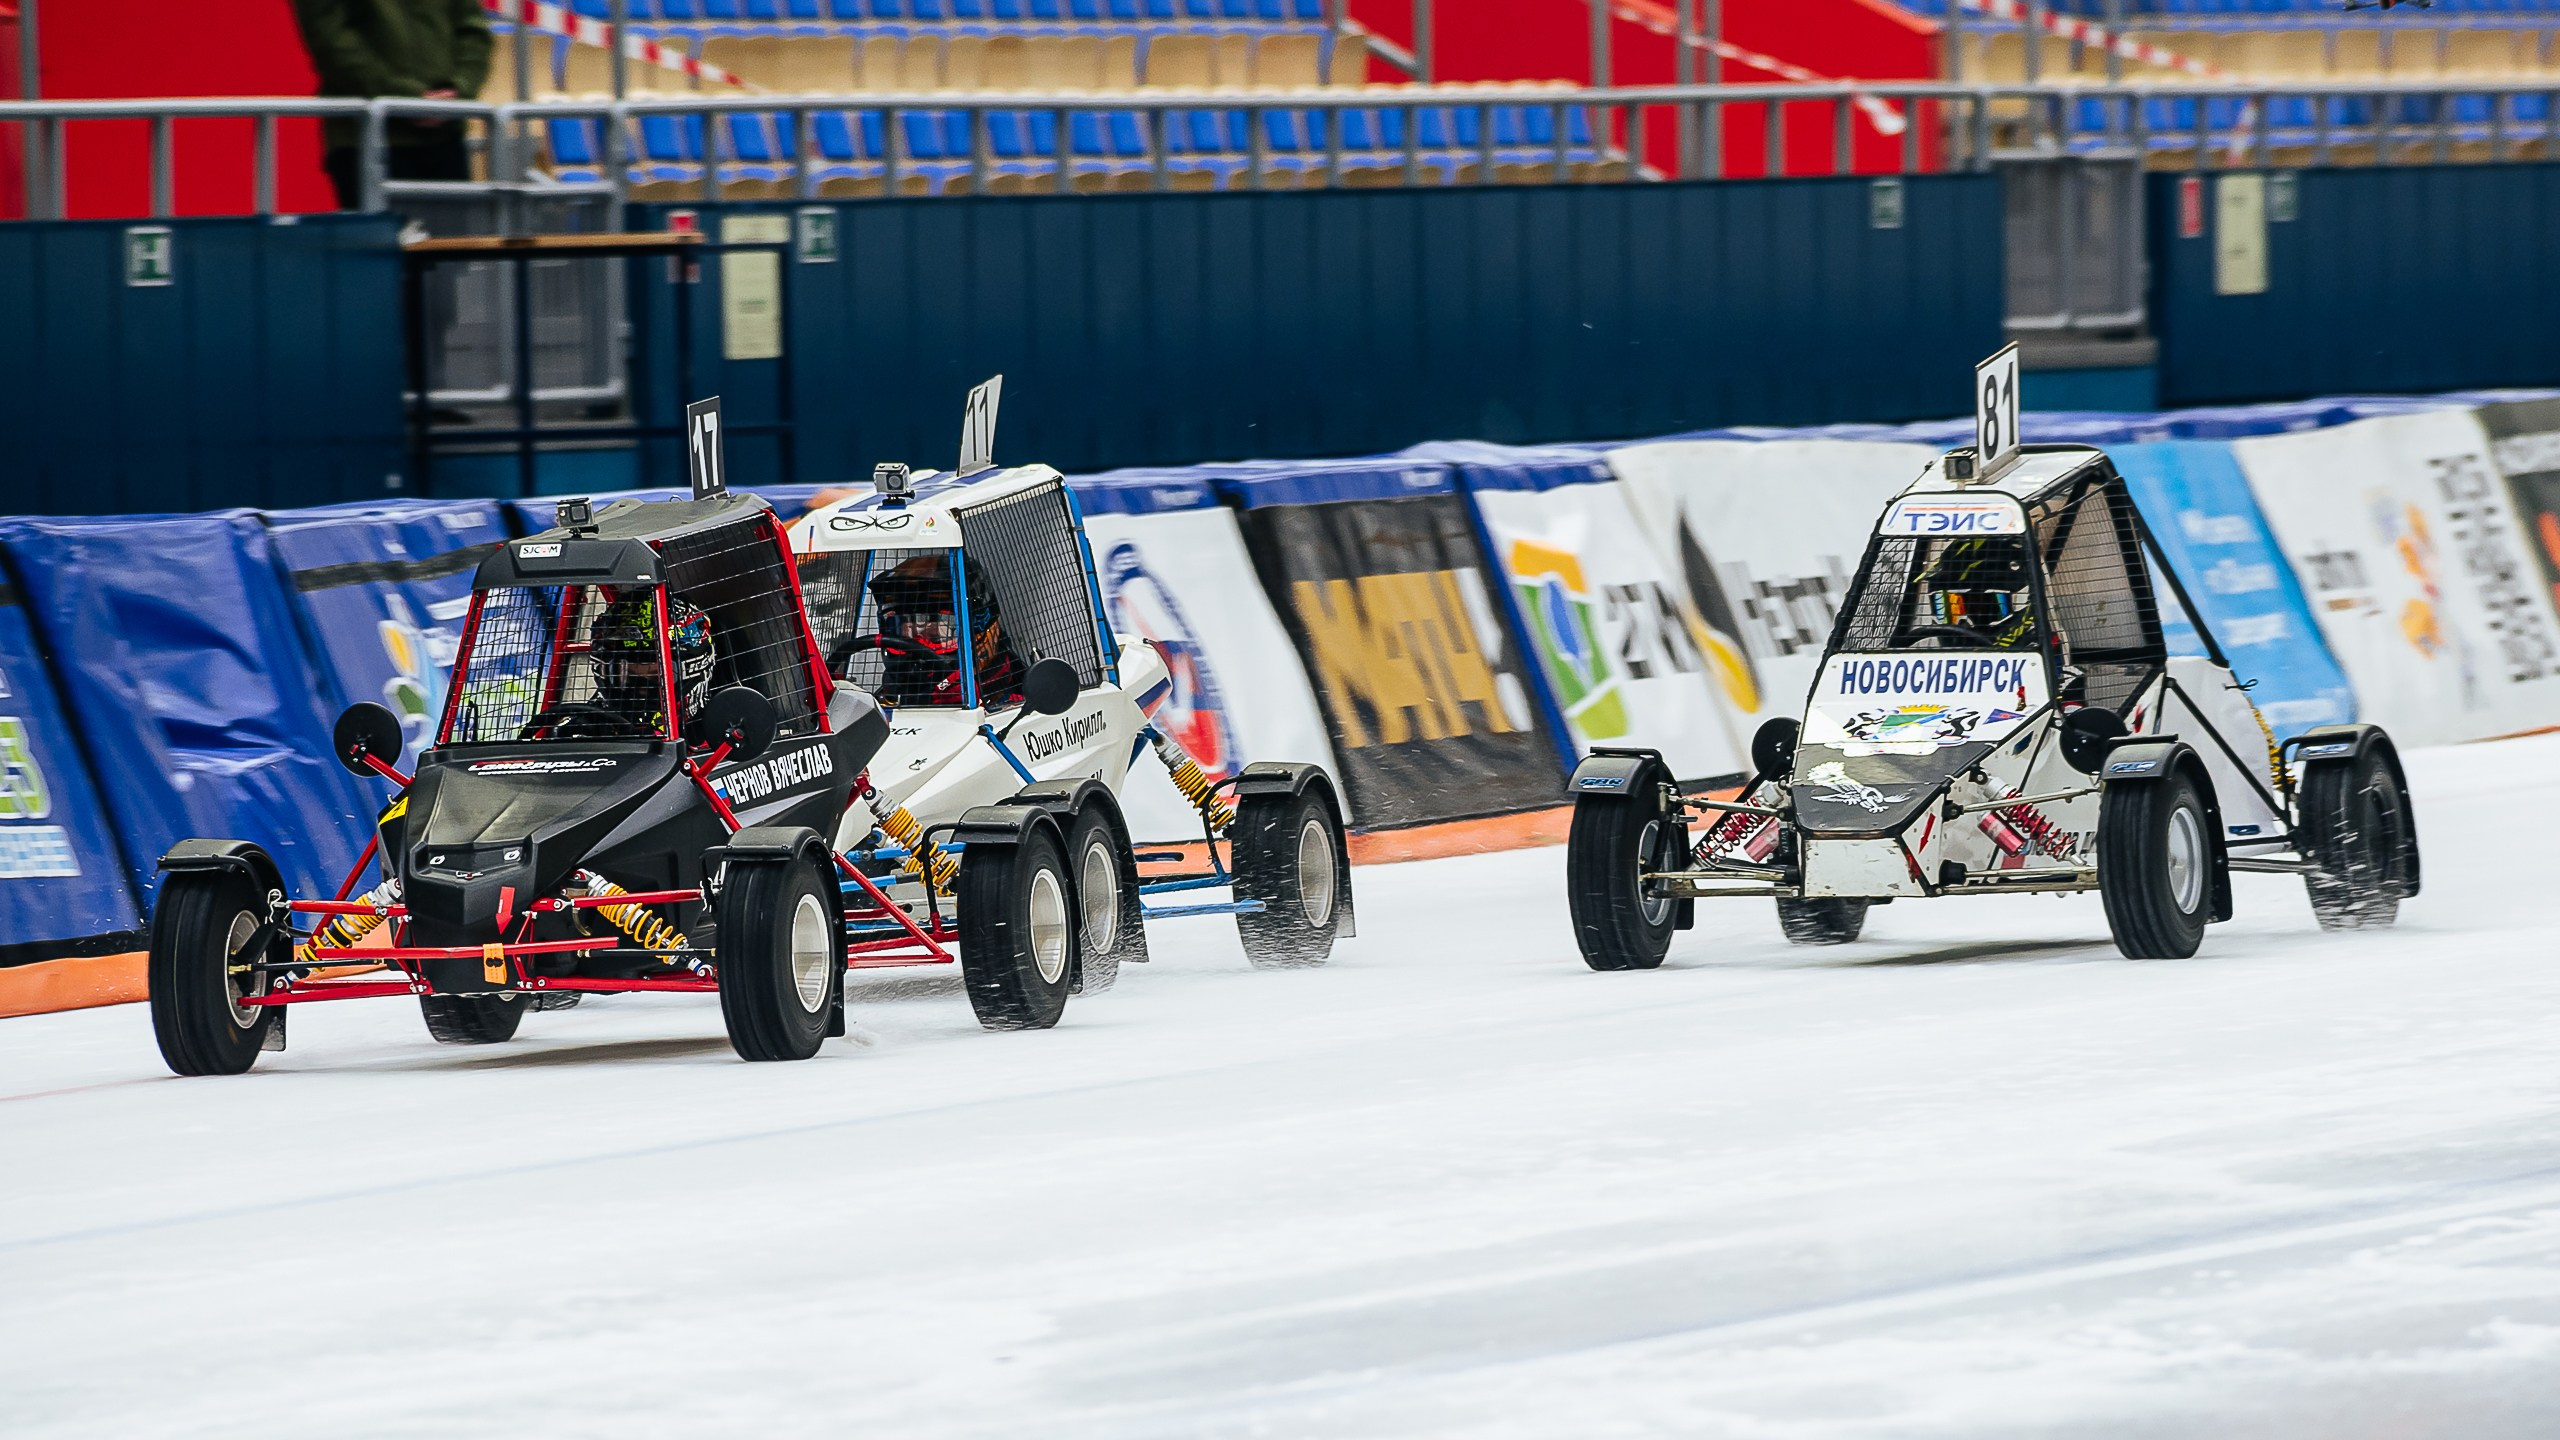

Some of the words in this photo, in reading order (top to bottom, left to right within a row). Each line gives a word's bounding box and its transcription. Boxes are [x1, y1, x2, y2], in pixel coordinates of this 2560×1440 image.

[967, 386, 989, 462] 11
[1984, 361, 2014, 460] 81
[693, 411, 719, 490] 17
[1904, 512, 2000, 531] ТЭИС
[1840, 659, 2027, 694] НОВОСИБИРСК
[723, 763, 773, 805] ЧЕРНОВ
[768, 743, 833, 790] ВЯЧЕСЛАВ
[1023, 730, 1063, 762] Юшко
